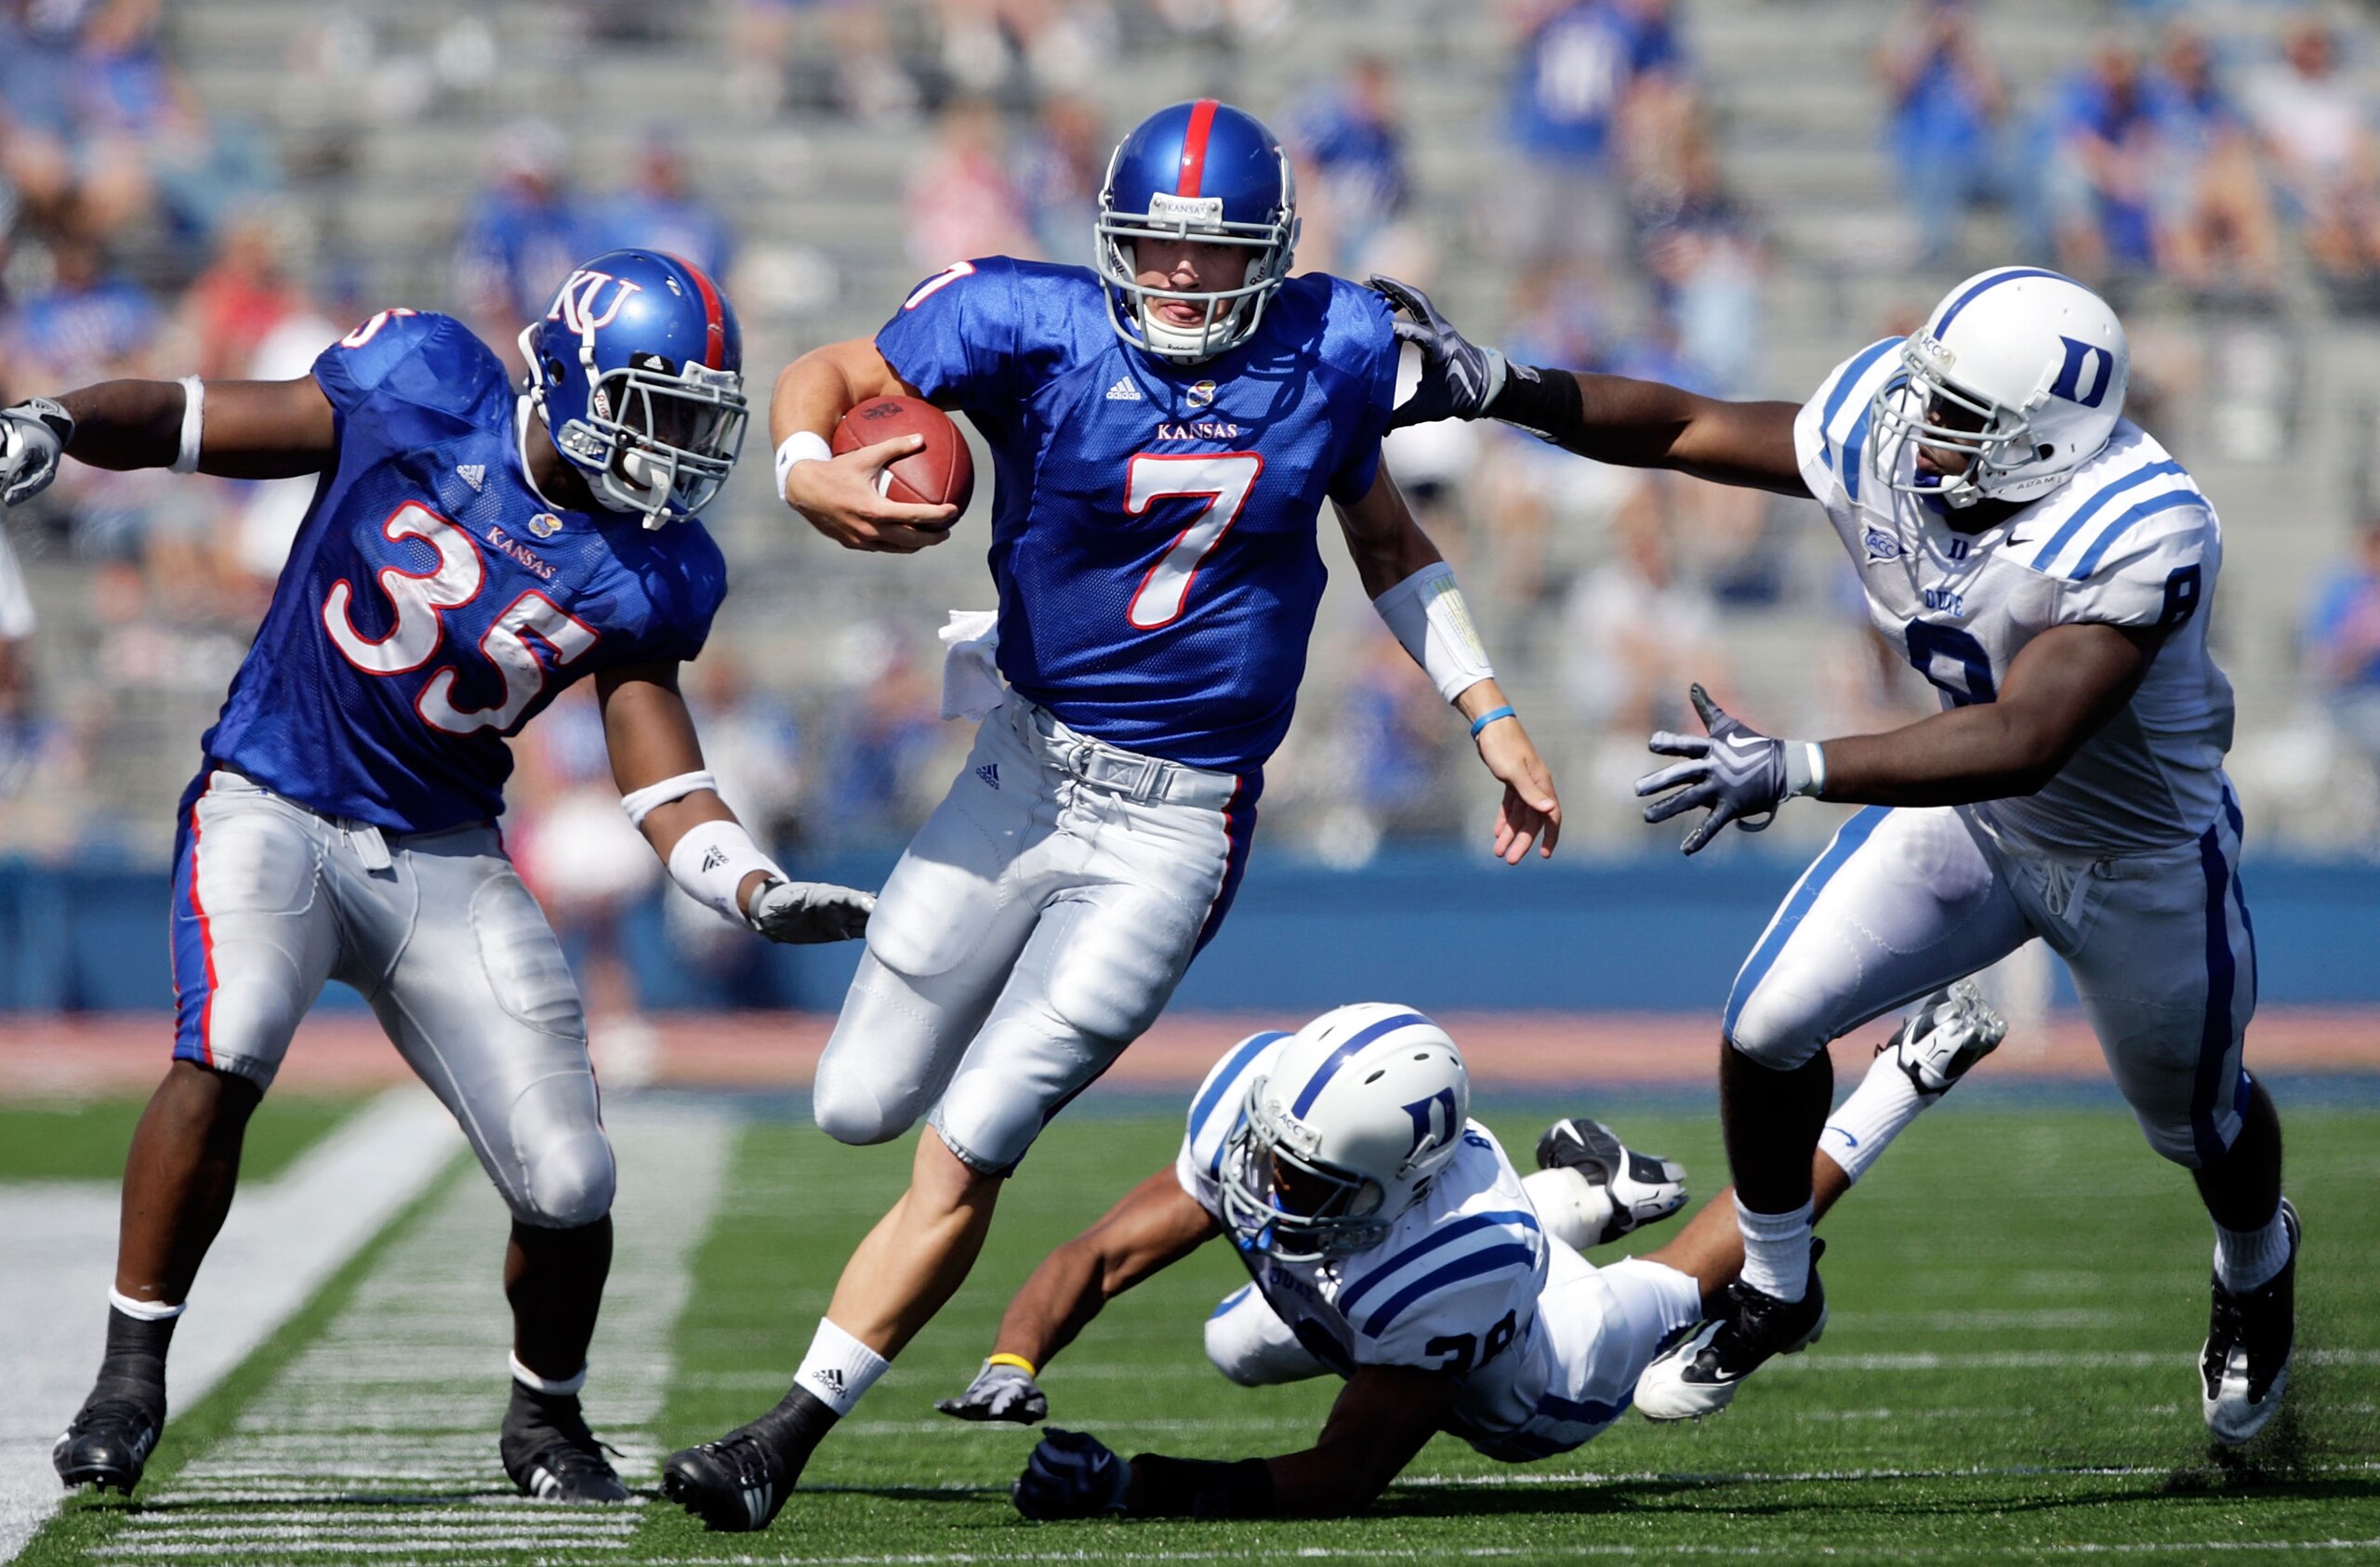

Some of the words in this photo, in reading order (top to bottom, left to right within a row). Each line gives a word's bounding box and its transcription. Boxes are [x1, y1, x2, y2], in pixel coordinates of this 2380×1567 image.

[546, 269, 643, 335] KU
[1922, 336, 1942, 357] ACC
[2049, 336, 2115, 408] D
[1106, 391, 1142, 401] adidas
[1157, 423, 1238, 440] KANSAS
[485, 525, 556, 579] KANSAS
[1124, 451, 1264, 630] 7
[1869, 537, 1895, 557] ACC
[322, 499, 602, 738] 35
[976, 768, 1000, 790] adidas
[1279, 1113, 1307, 1136] ACC
